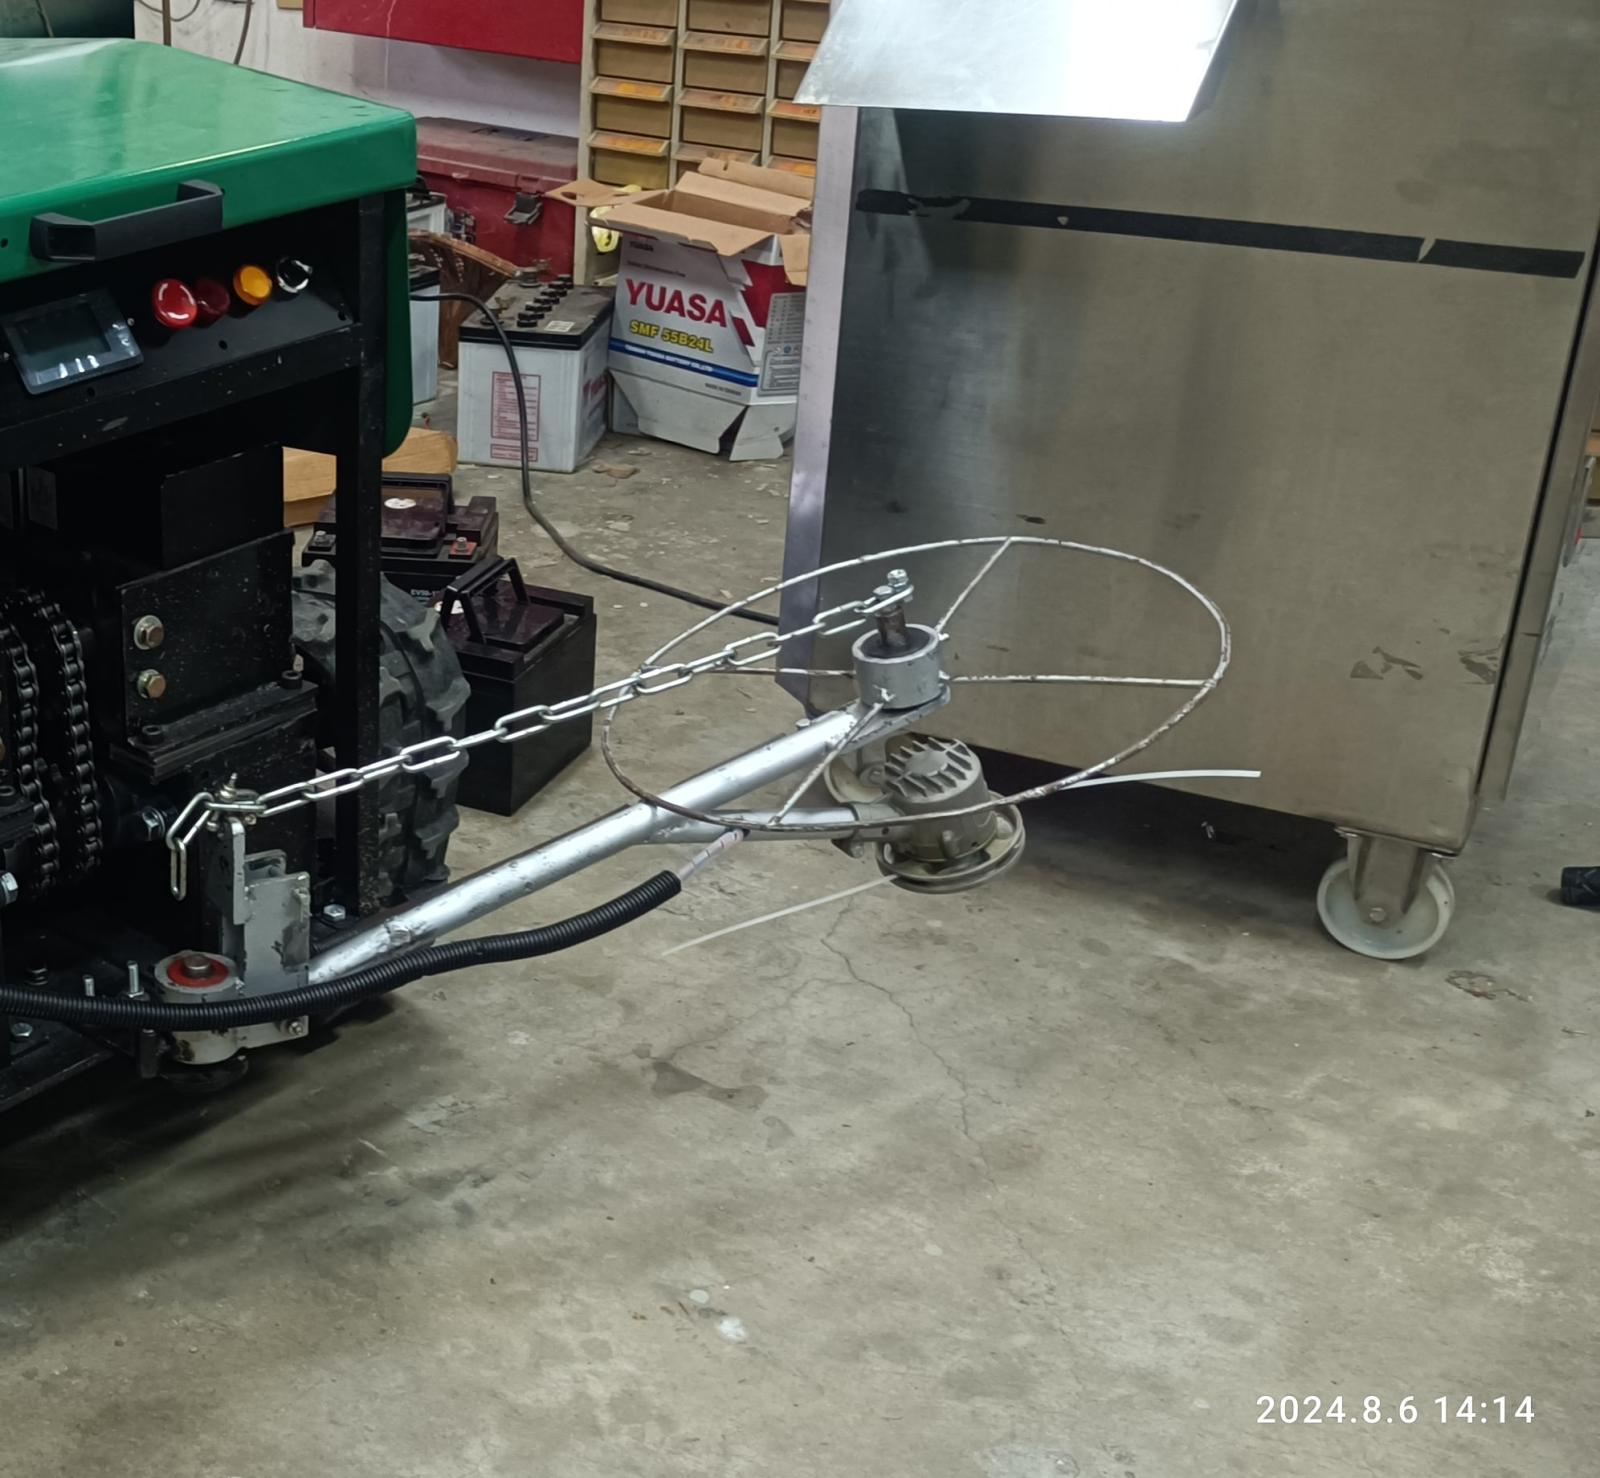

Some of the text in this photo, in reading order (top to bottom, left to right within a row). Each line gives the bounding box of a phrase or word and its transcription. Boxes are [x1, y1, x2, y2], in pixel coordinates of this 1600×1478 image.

[625, 278, 728, 328] YUASA
[629, 319, 715, 354] SMF 55B24L
